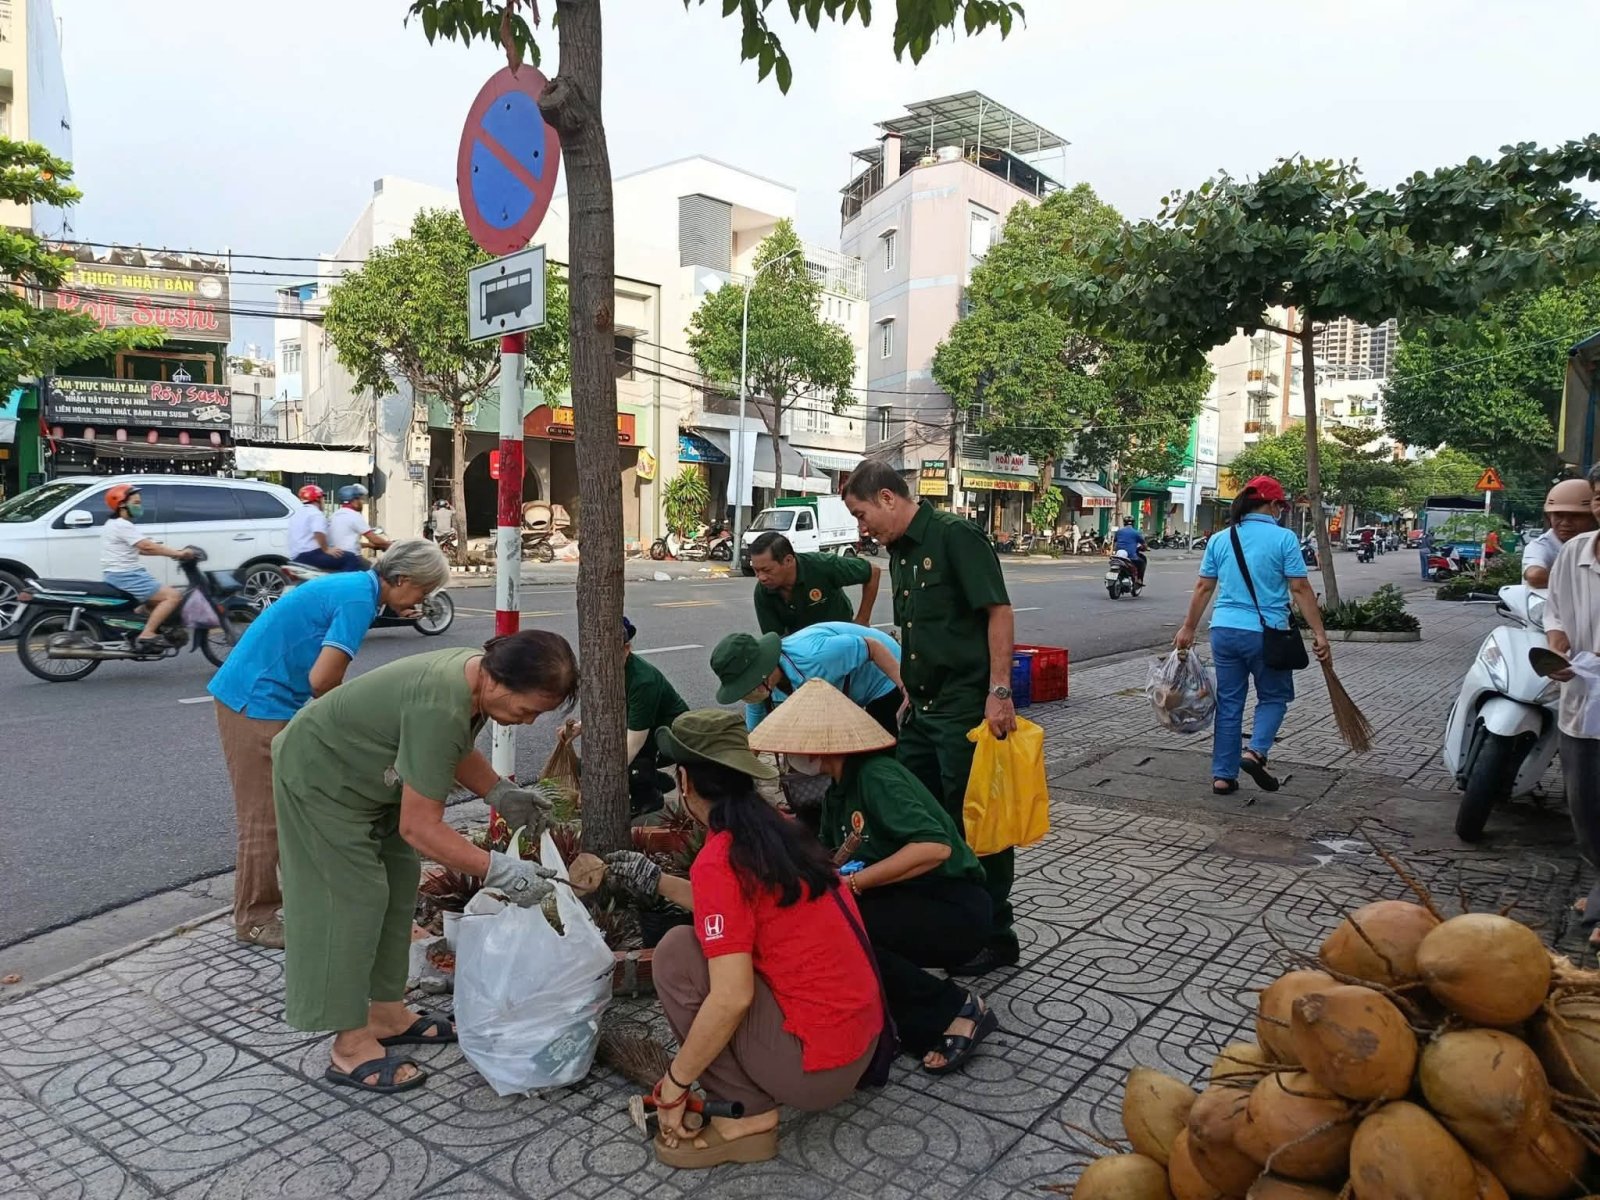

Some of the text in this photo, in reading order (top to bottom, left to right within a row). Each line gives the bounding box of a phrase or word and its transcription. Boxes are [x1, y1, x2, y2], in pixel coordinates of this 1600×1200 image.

[78, 270, 117, 287] THỰC
[122, 274, 160, 291] NHẬT
[164, 276, 194, 292] BẢN
[55, 290, 219, 332] Roji Sushi
[74, 381, 98, 392] THỰC
[128, 382, 147, 393] BẢN
[186, 386, 230, 406] Sushi
[169, 410, 189, 418] SUSHI
